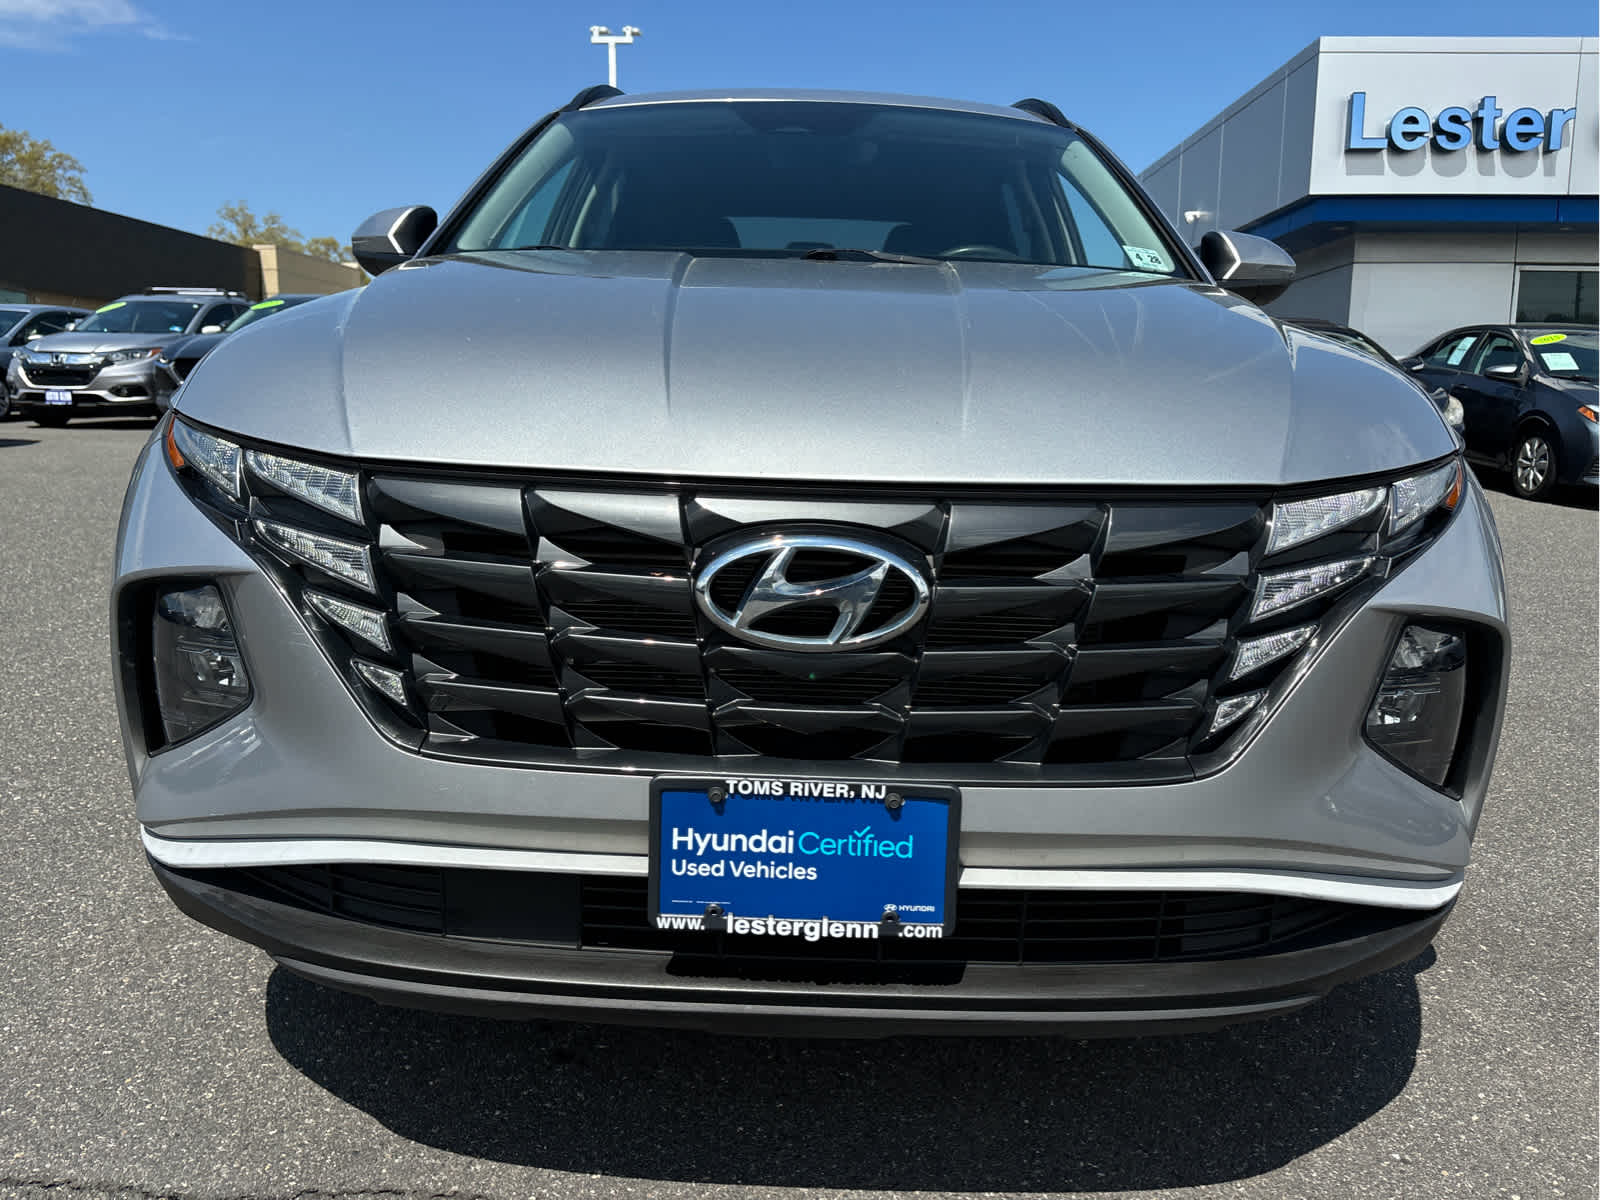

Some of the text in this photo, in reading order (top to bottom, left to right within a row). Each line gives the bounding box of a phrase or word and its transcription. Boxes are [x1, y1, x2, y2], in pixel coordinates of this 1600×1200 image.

[1346, 91, 1576, 151] Lester
[725, 780, 887, 800] TOMS RIVER, NJ
[671, 826, 913, 858] Hyundai Certified
[671, 859, 818, 880] Used Vehicles
[656, 913, 943, 941] www. lesterglenn .com
